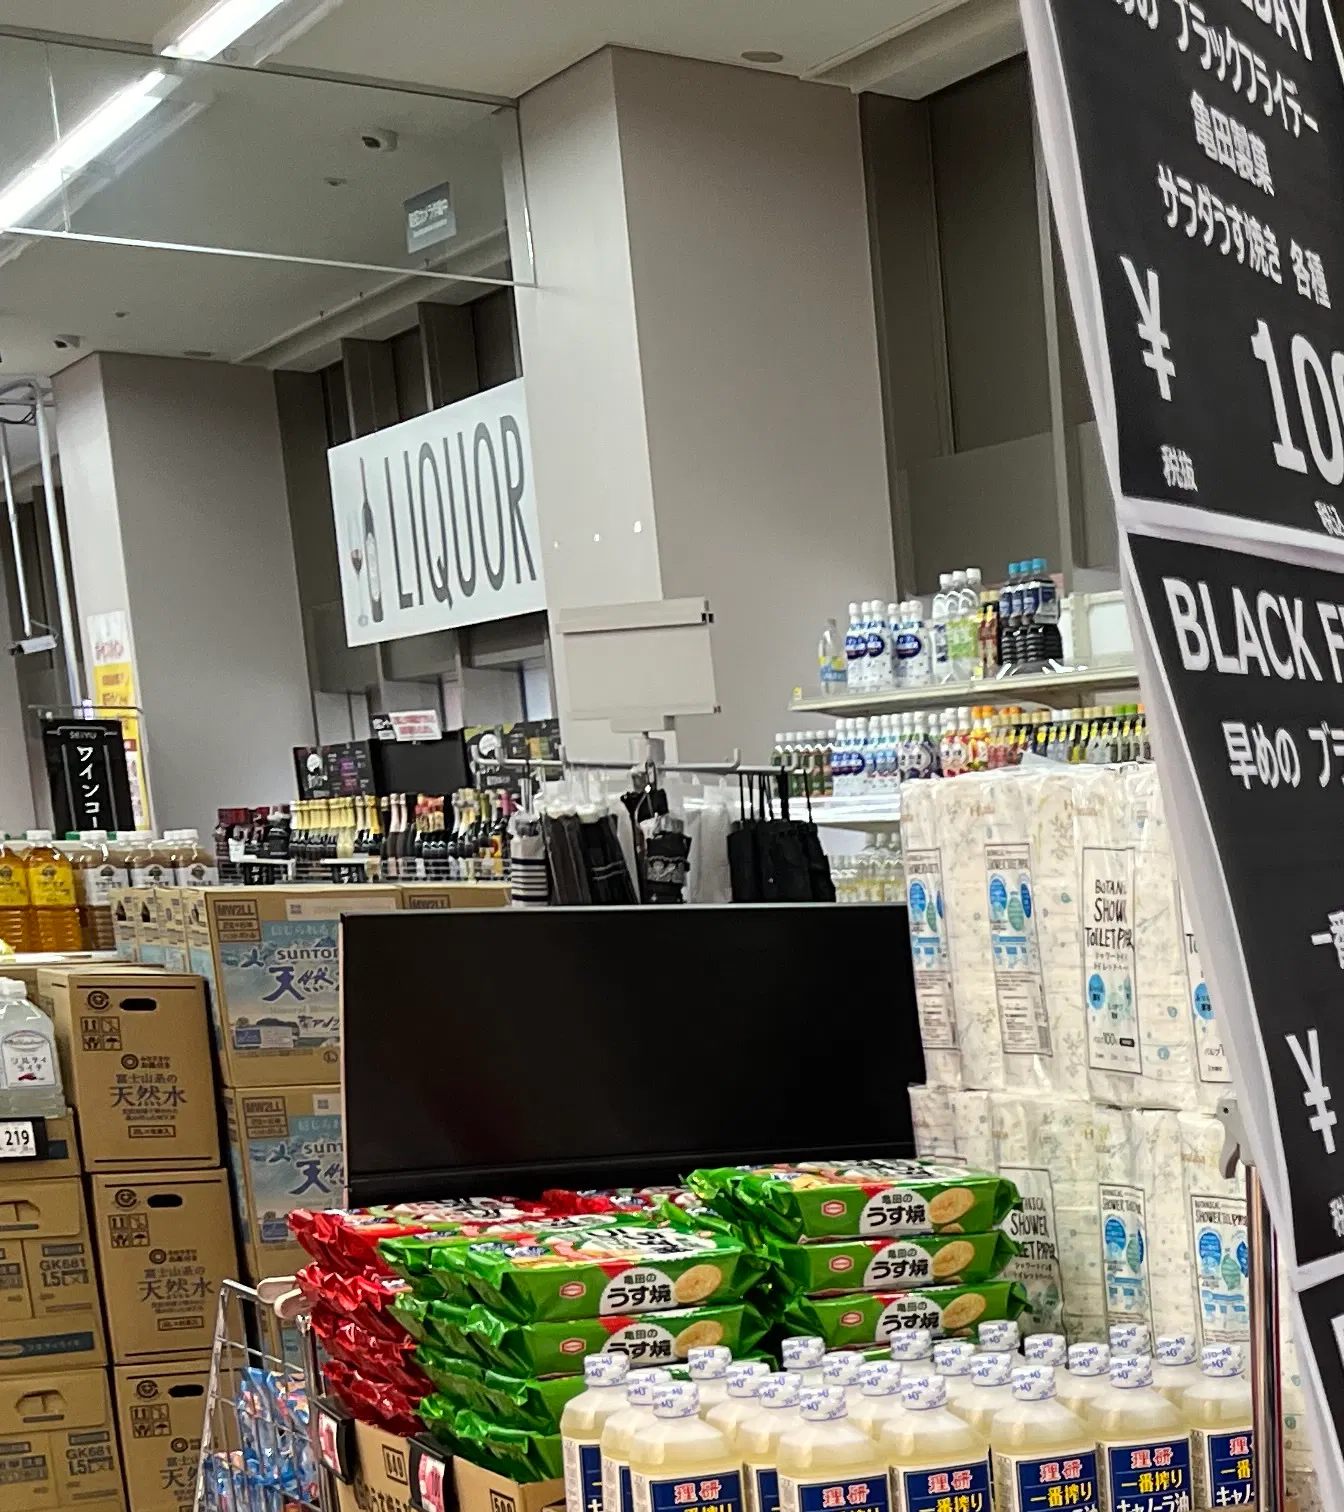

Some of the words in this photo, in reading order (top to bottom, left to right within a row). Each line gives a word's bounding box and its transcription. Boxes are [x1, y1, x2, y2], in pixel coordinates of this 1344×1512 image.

[1190, 89, 1275, 196] 亀田製菓
[1157, 163, 1283, 285] サラダうす焼き
[1290, 238, 1331, 309] 各種
[385, 414, 537, 610] LIQUOR
[1163, 576, 1323, 684] BLACK
[1221, 720, 1300, 792] 早めの
[262, 966, 340, 1002] 天然
[109, 1085, 188, 1108] 天然水
[5, 1130, 29, 1146] 219
[866, 1205, 926, 1227] うす焼
[871, 1259, 929, 1280] うす焼
[138, 1277, 215, 1303] 天然水
[607, 1285, 672, 1308] うす焼
[882, 1312, 940, 1334] うす焼
[1130, 1447, 1174, 1470] 理研
[928, 1470, 973, 1494] 理研
[1039, 1459, 1083, 1483] 理研
[1121, 1468, 1183, 1493] 一番搾り
[673, 1480, 722, 1504] 理研
[822, 1484, 870, 1508] 理研
[1030, 1482, 1092, 1508] 一番搾り
